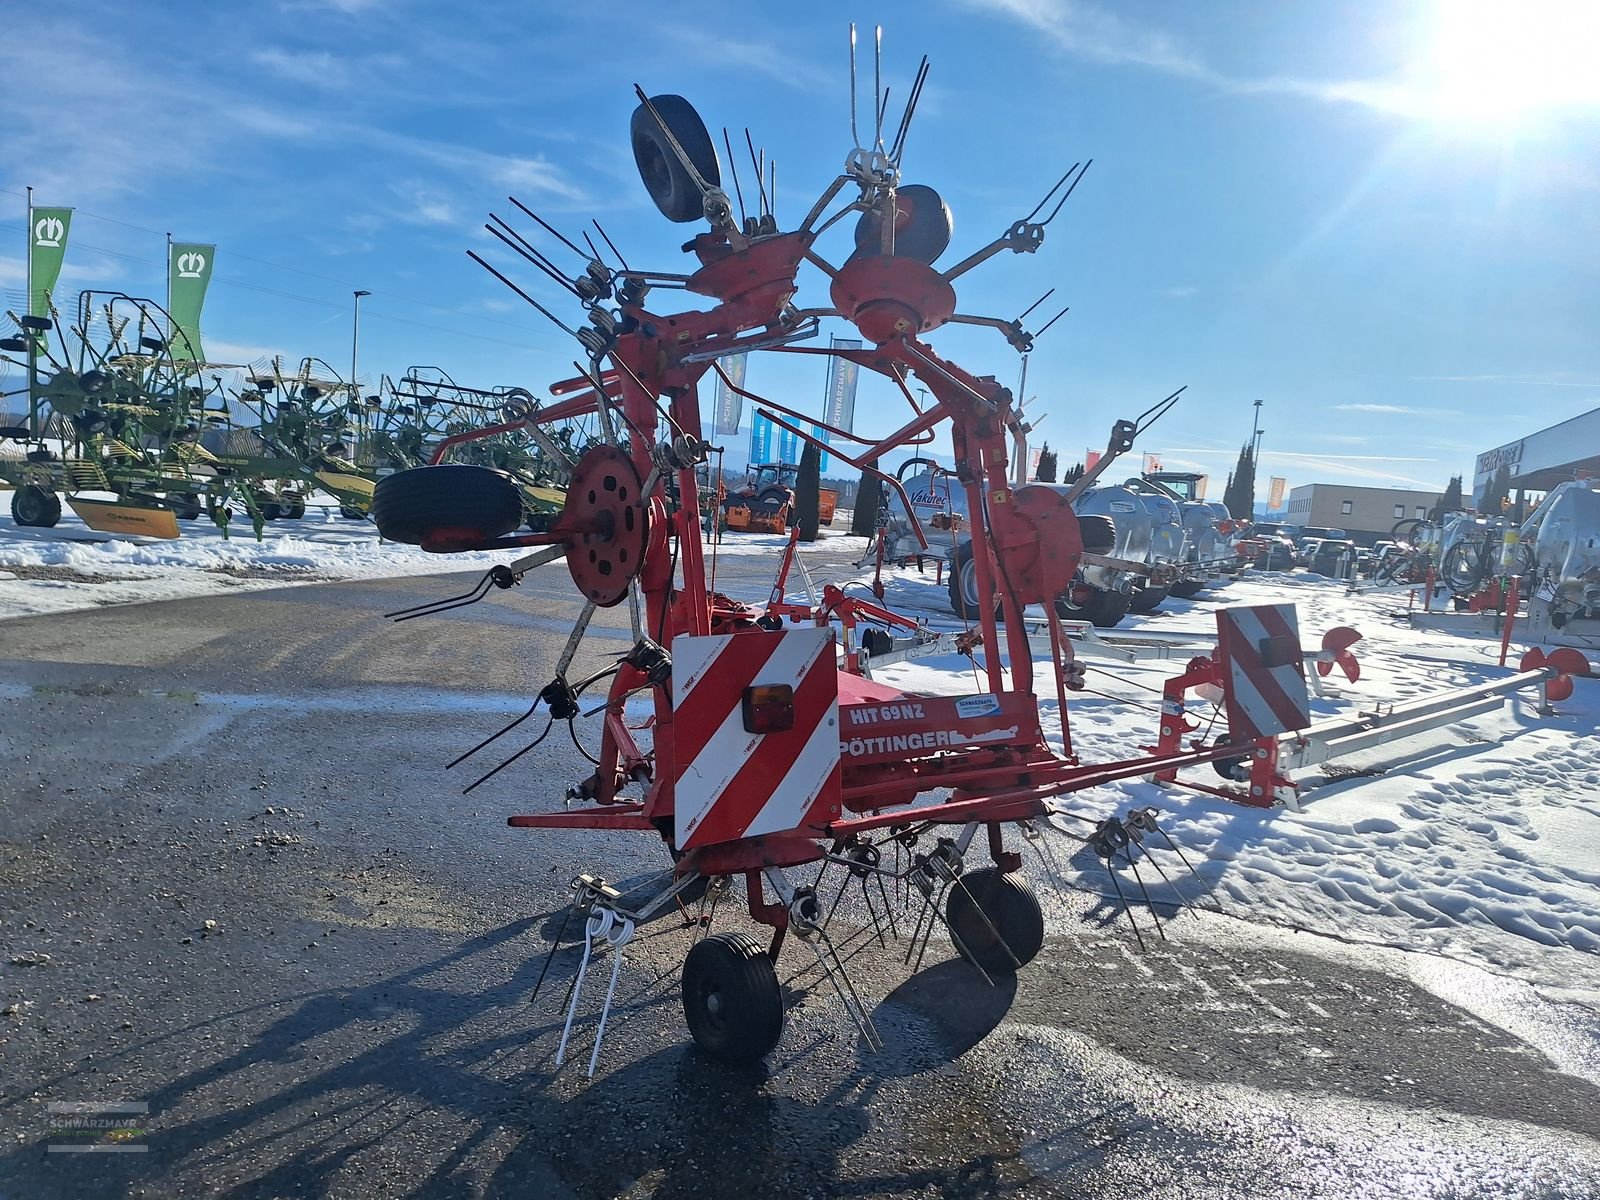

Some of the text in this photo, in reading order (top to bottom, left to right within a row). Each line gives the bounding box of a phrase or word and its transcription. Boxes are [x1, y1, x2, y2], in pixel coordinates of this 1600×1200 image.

[833, 360, 846, 428] SCHWARZMAYR
[911, 490, 947, 505] Vakutec
[849, 707, 878, 725] HIT
